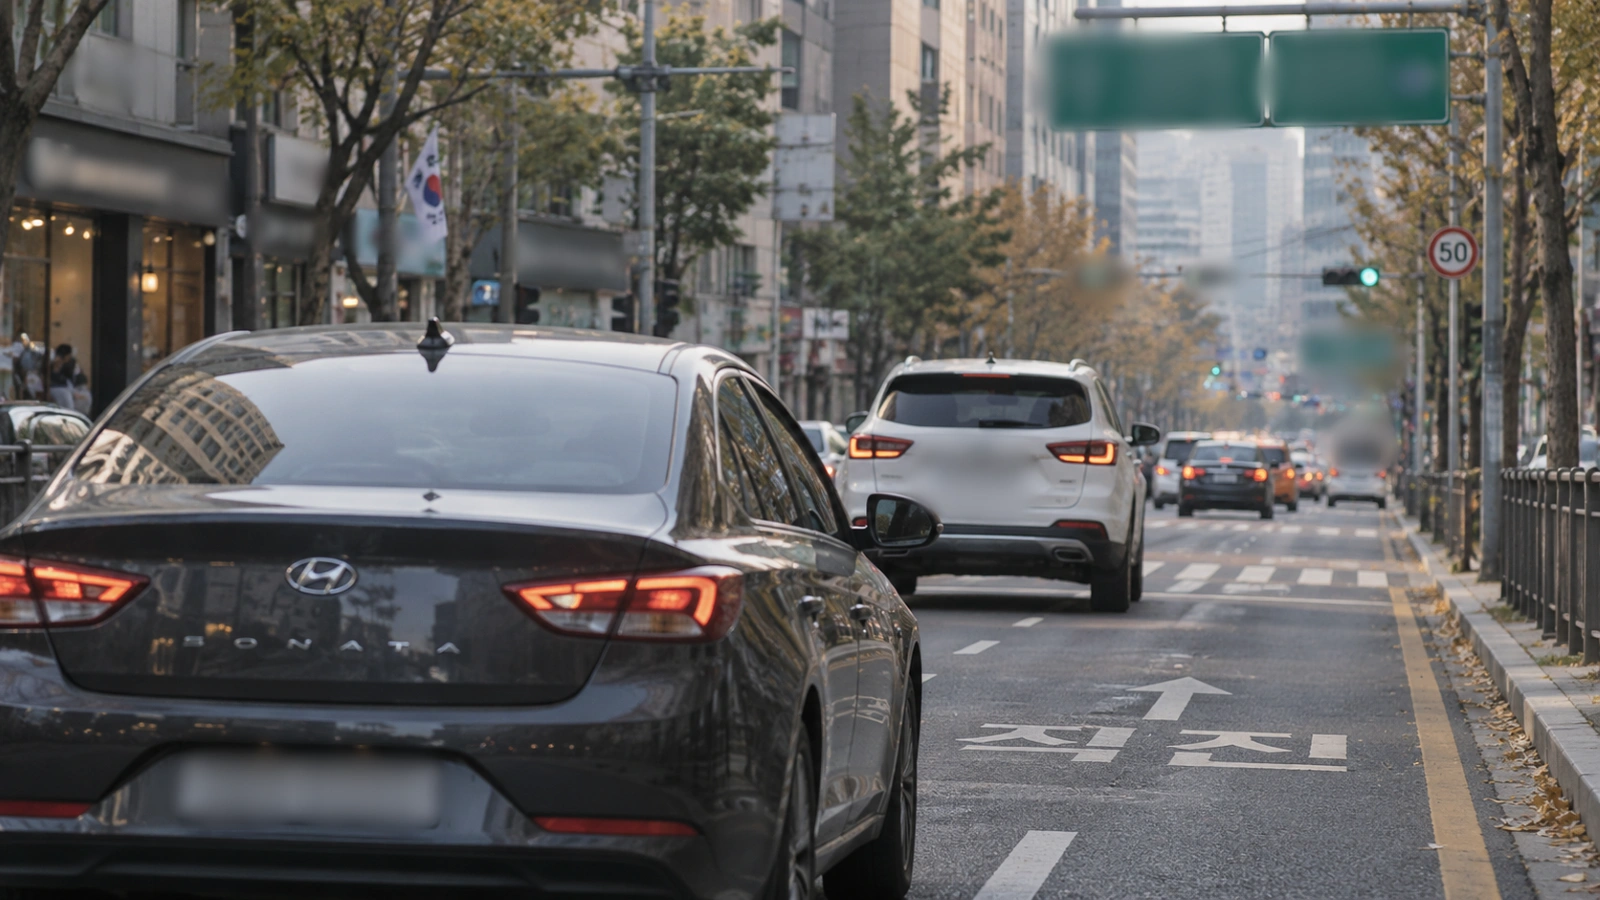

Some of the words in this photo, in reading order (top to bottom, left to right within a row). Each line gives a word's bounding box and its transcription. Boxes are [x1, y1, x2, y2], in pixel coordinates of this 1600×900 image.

[1440, 242, 1467, 262] 50
[183, 635, 460, 654] SONATA
[955, 723, 1347, 772] 직진
